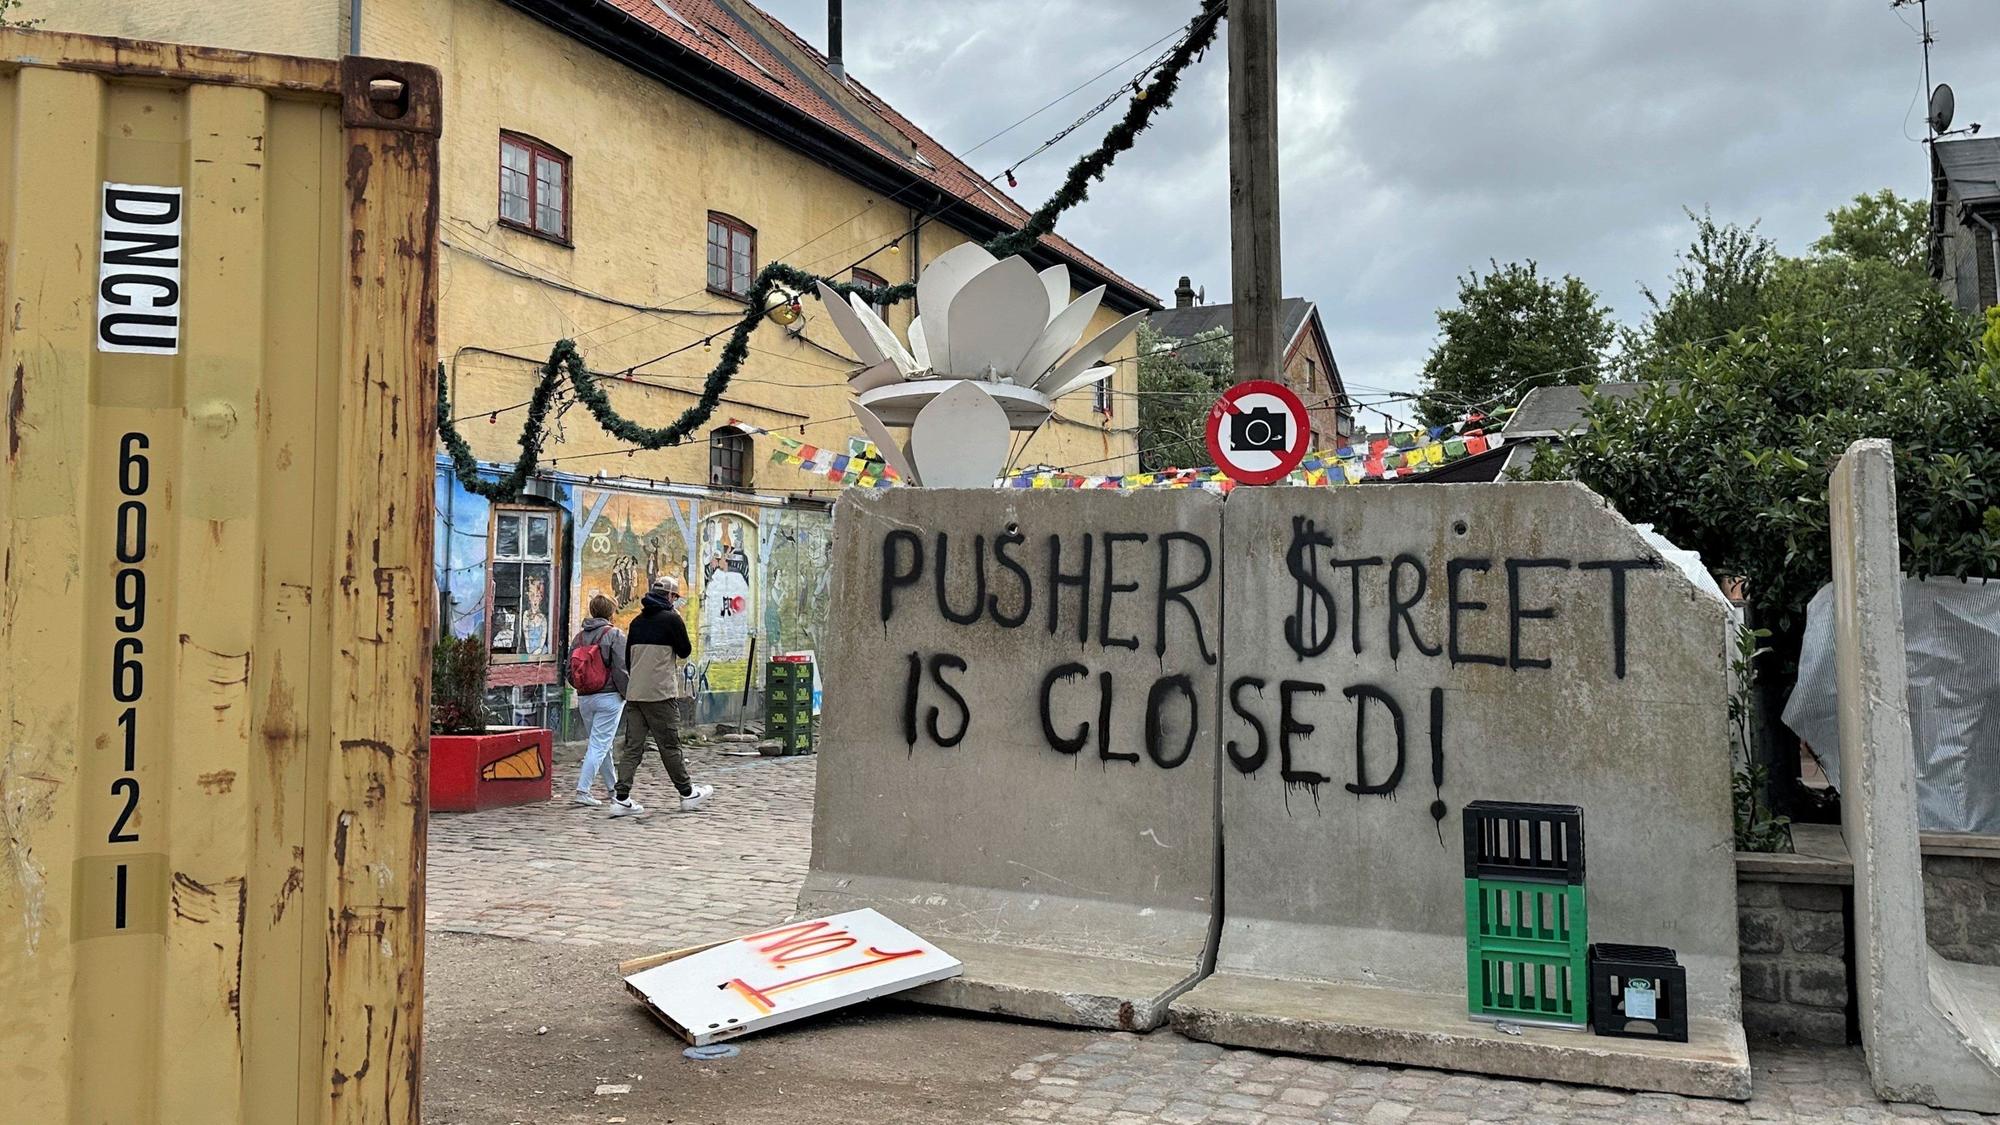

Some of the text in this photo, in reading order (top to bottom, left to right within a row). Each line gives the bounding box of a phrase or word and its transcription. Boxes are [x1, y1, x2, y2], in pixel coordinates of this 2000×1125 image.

[100, 188, 180, 348] DNCU
[108, 432, 150, 843] 609612
[881, 516, 1664, 680] PUSHER $TREET
[904, 652, 1446, 838] IS CLOSED!
